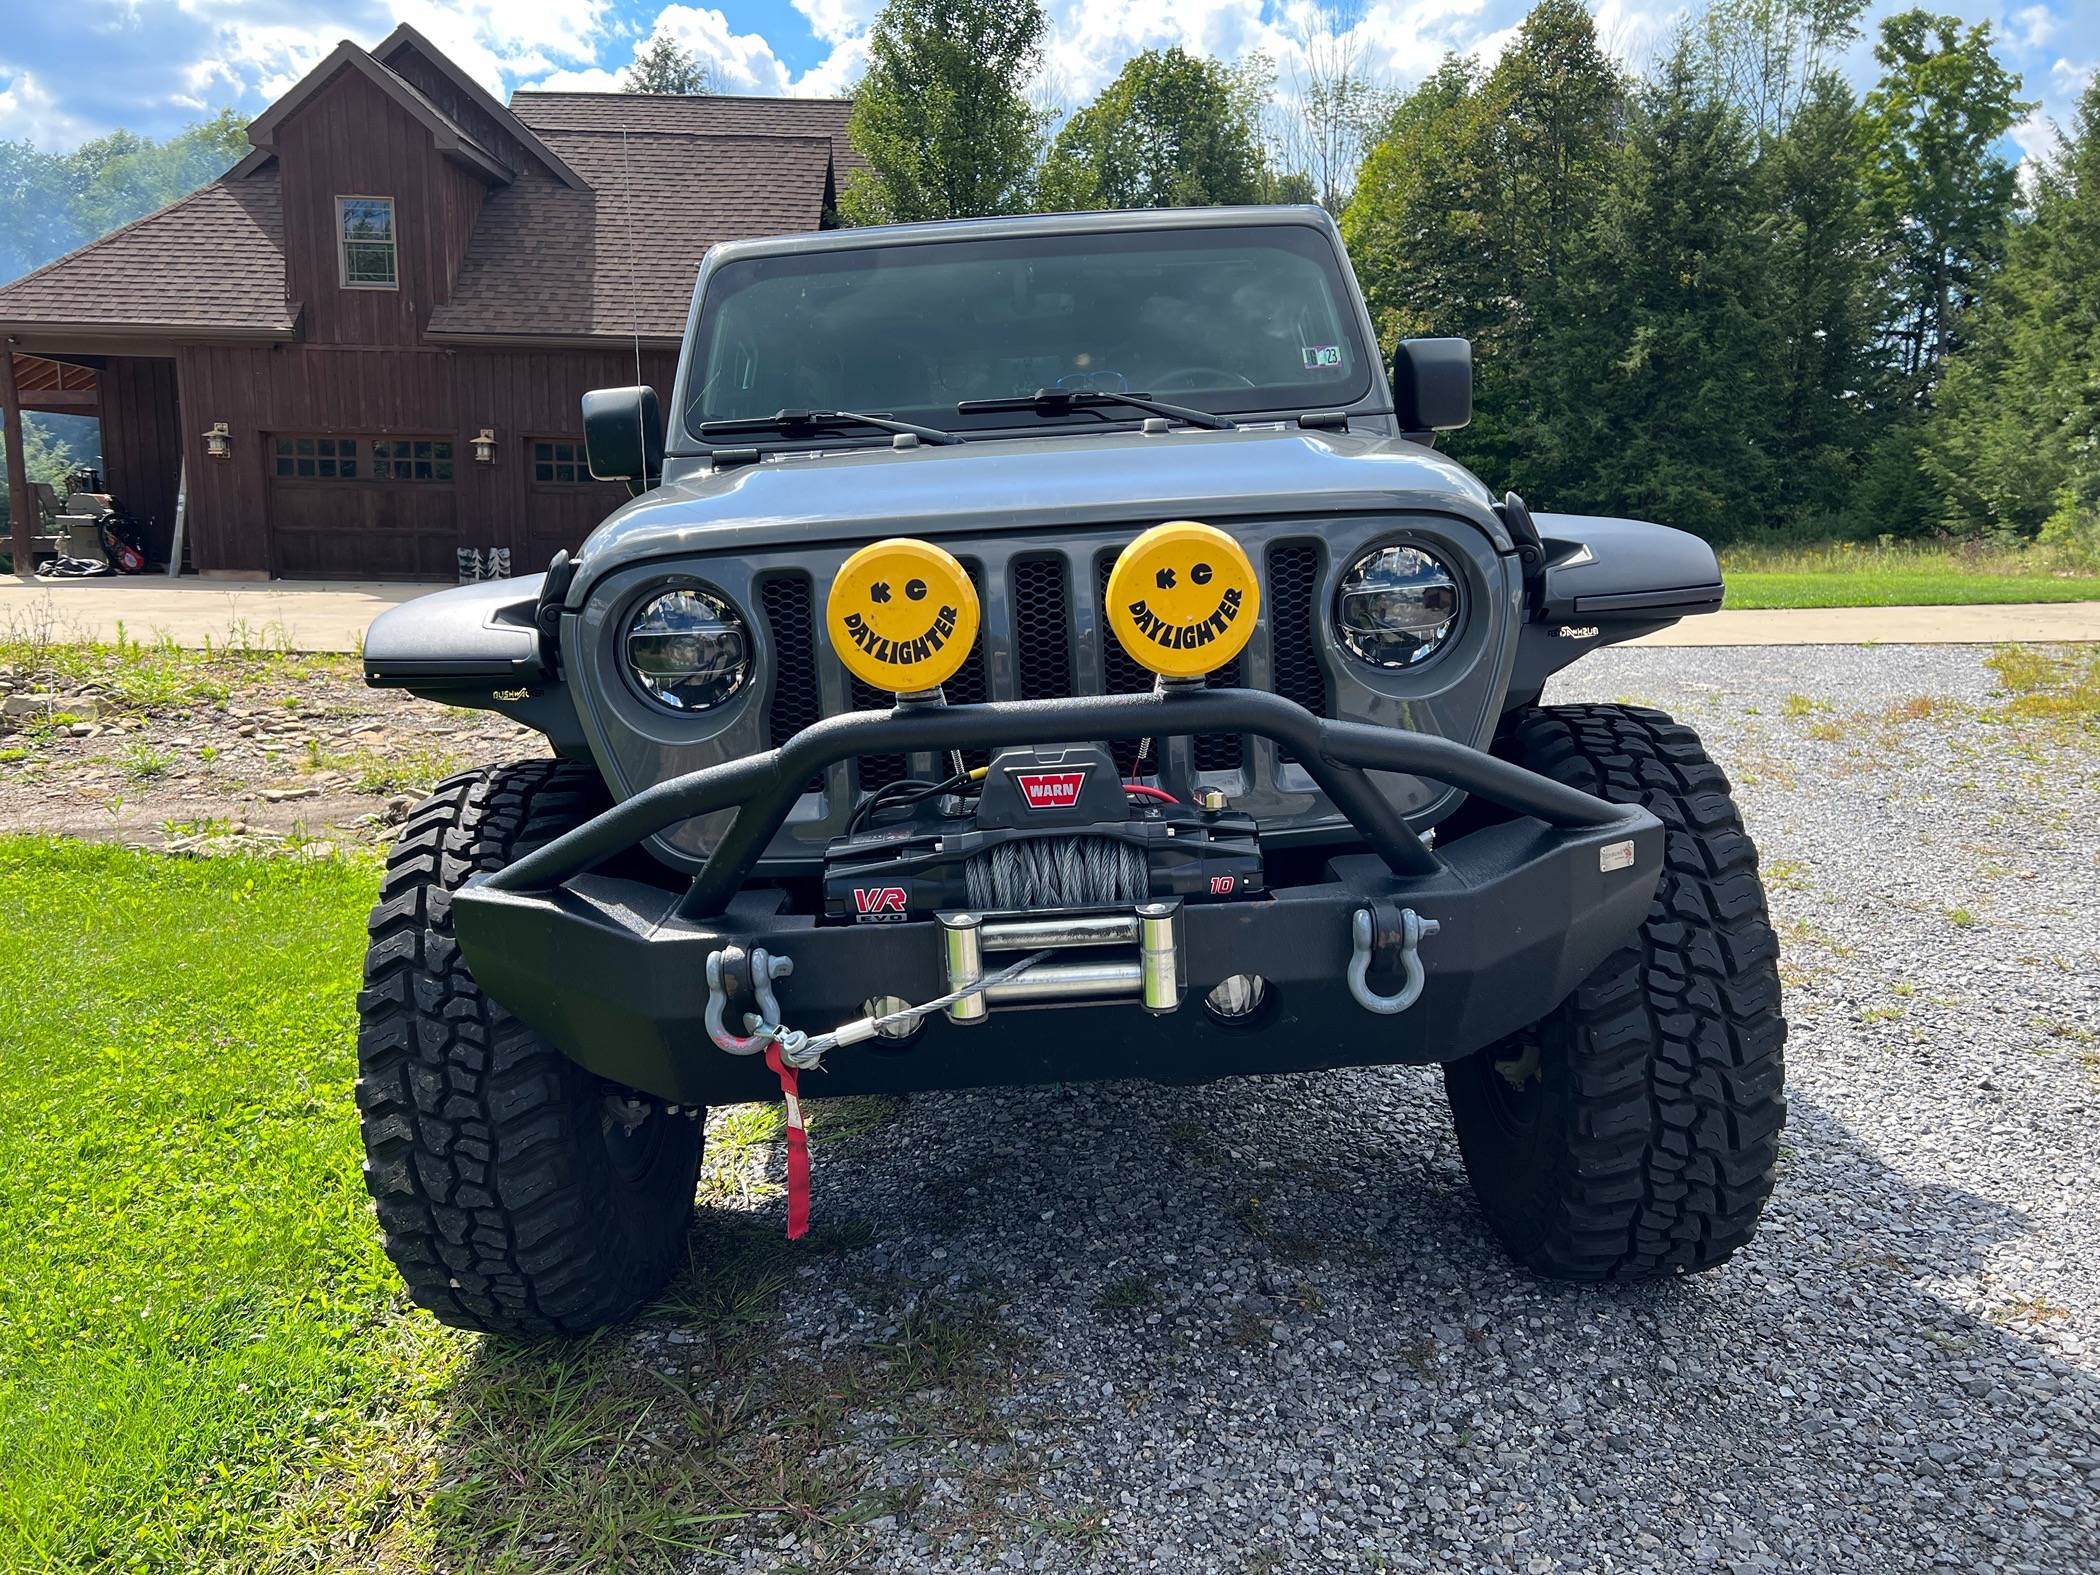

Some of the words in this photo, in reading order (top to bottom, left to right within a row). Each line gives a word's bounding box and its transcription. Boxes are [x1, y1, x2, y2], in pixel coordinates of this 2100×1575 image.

[1326, 348, 1338, 364] 23
[1128, 587, 1243, 650] DAYLIGHTER
[843, 604, 957, 665] DAYLIGHTER
[1029, 783, 1074, 798] WARN
[1210, 876, 1235, 895] 10
[853, 887, 907, 913] VR
[860, 914, 903, 922] EVO
